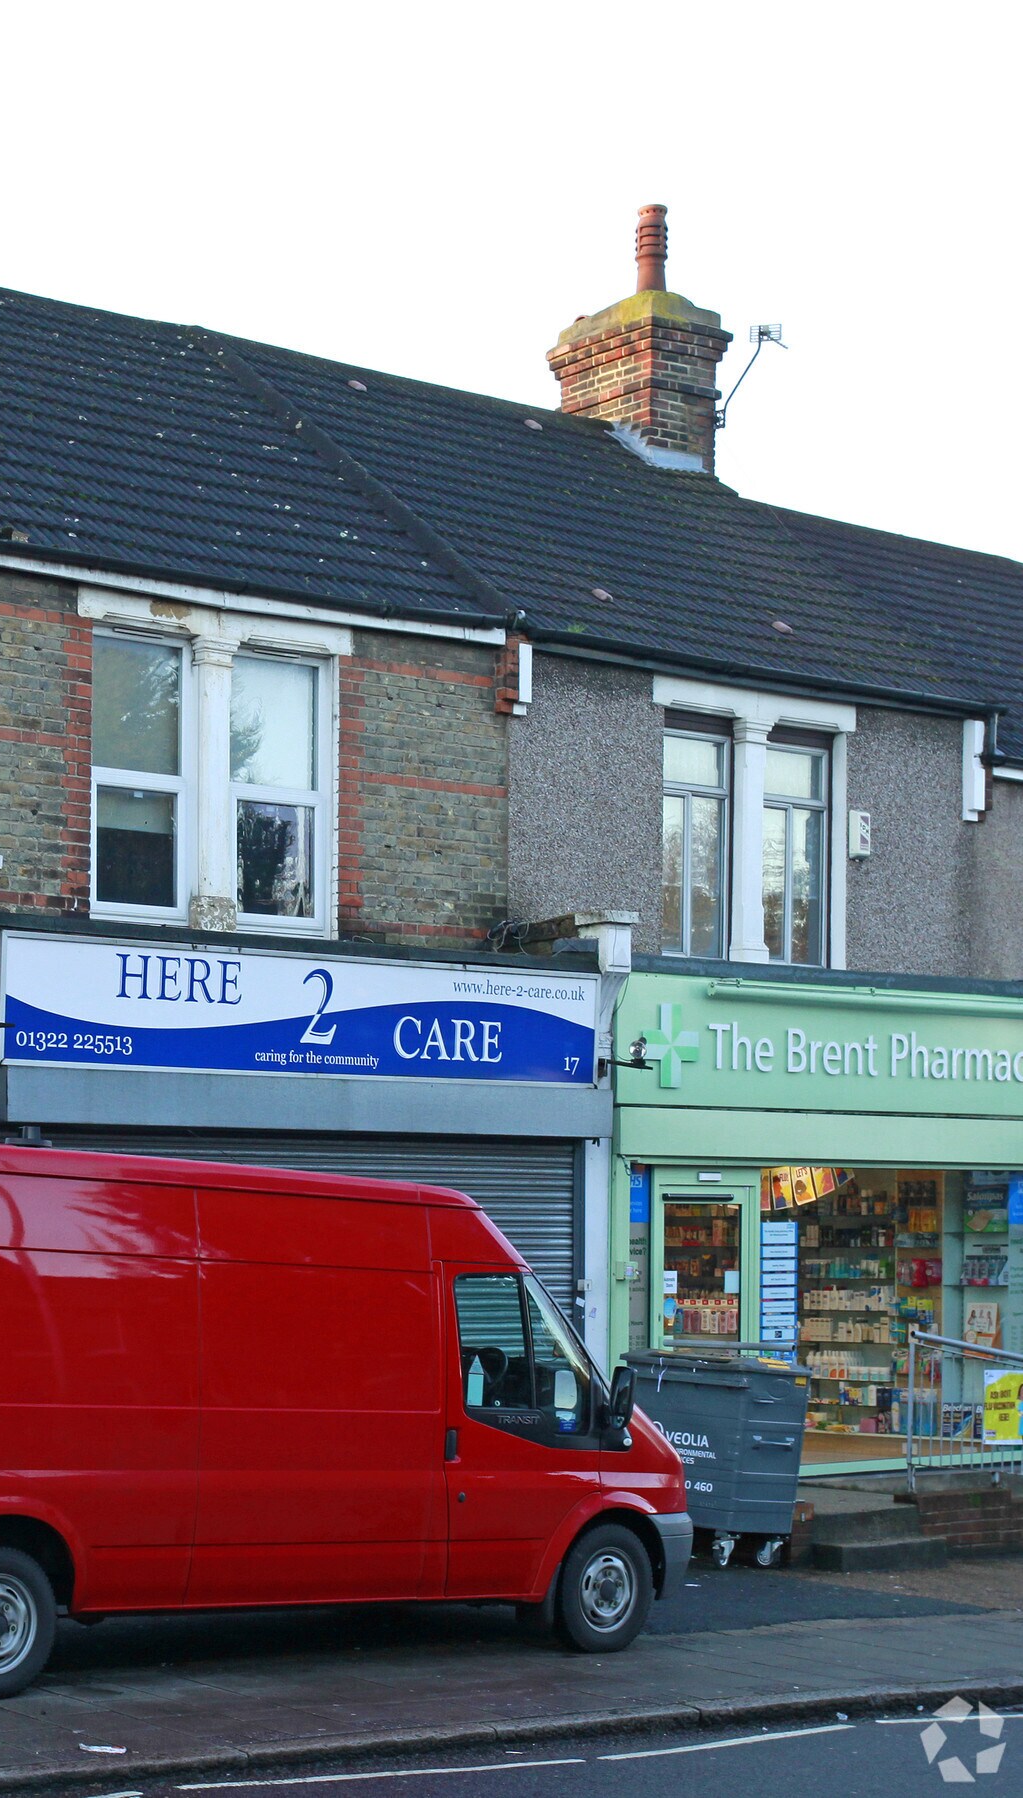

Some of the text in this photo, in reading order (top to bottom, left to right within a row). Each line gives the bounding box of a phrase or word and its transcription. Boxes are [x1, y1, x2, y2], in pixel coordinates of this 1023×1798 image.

[115, 952, 243, 1006] HERE
[452, 978, 586, 1002] www.here-2-care.co.uk
[299, 967, 337, 1046] 2
[15, 1031, 134, 1057] 01322 225513
[392, 1015, 503, 1064] CARE
[254, 1049, 380, 1070] caring for the community
[708, 1021, 1023, 1083] The Brent Pharmac
[563, 1056, 580, 1077] 17
[630, 1175, 642, 1187] HS
[966, 1191, 1004, 1203] Salonpas
[497, 1414, 541, 1426] TRANSIT
[666, 1431, 709, 1447] VEOLIA
[676, 1447, 717, 1460] IRONMENTAL
[693, 1482, 714, 1493] 460
